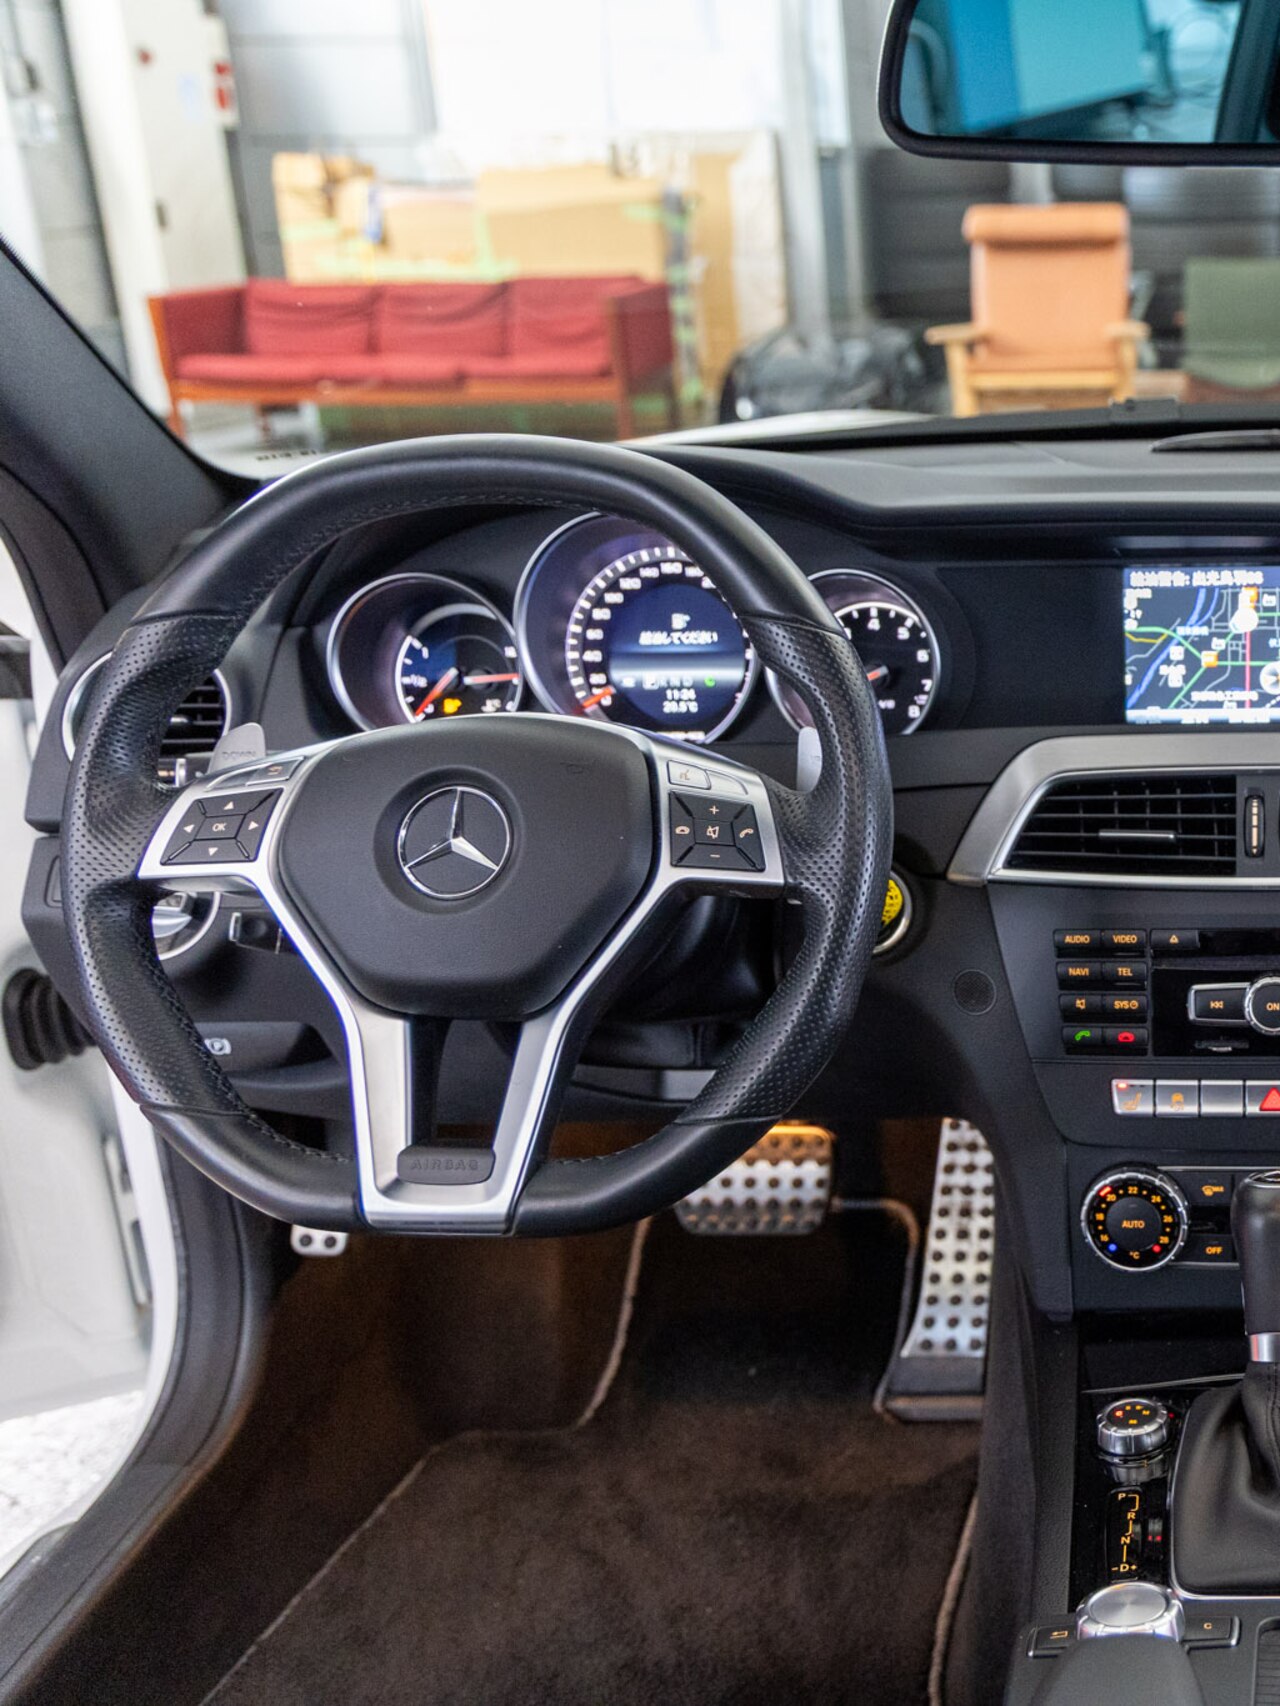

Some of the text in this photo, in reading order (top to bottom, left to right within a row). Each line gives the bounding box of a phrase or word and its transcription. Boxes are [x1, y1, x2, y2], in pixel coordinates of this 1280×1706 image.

[867, 618, 880, 631] 4
[897, 627, 910, 640] 5
[916, 650, 930, 663] 6
[921, 679, 932, 692] 7
[908, 705, 921, 718] 8
[212, 822, 227, 832] OK
[1064, 935, 1091, 943] AUDIO
[1112, 935, 1137, 943] VIDEO
[1068, 967, 1090, 976] NAVI
[1117, 967, 1133, 976] TEL
[1114, 1000, 1129, 1009] SYS
[1266, 1002, 1280, 1011] ON
[410, 1159, 479, 1171] AIRBAG
[1121, 1220, 1145, 1228] AUTO
[1205, 1246, 1222, 1254] OFF
[1121, 1536, 1131, 1544] N
